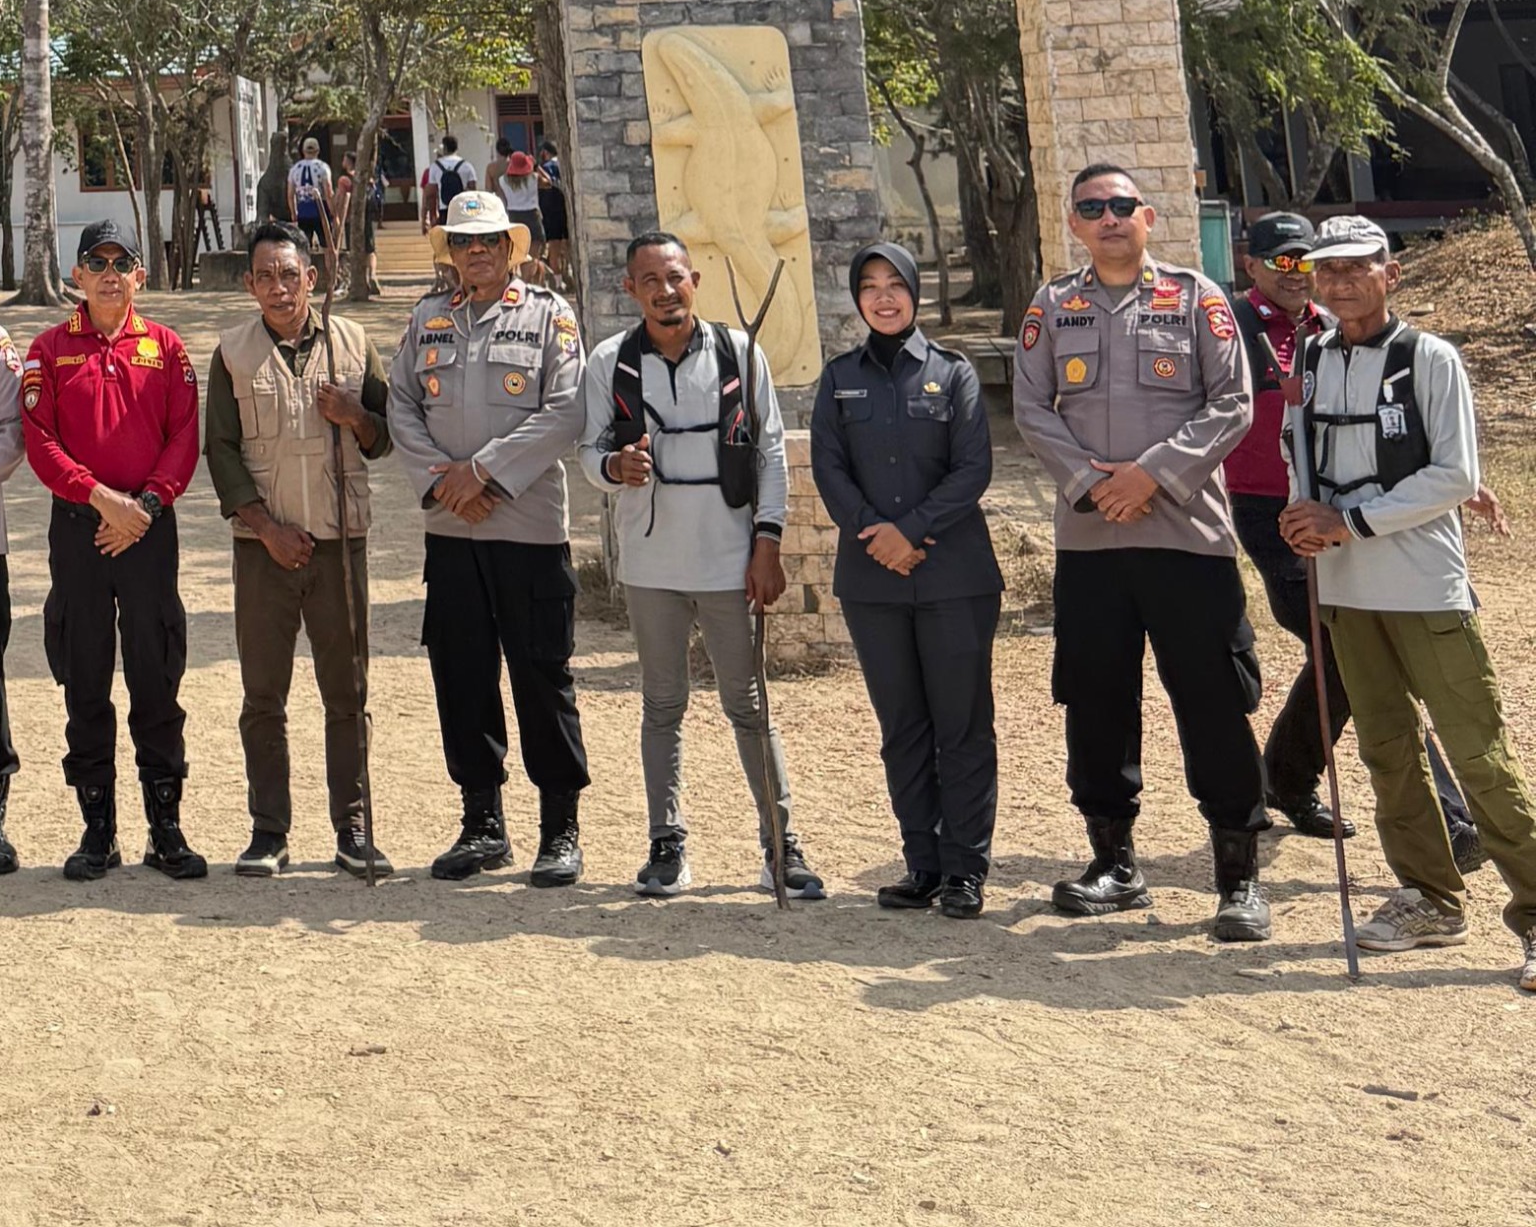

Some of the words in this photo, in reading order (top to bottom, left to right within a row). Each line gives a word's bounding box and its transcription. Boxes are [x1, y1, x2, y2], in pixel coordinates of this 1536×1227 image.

[1056, 315, 1096, 328] SANDY
[1140, 314, 1187, 325] POLRI
[419, 333, 455, 346] ABNEL
[496, 330, 539, 343] POLRI
